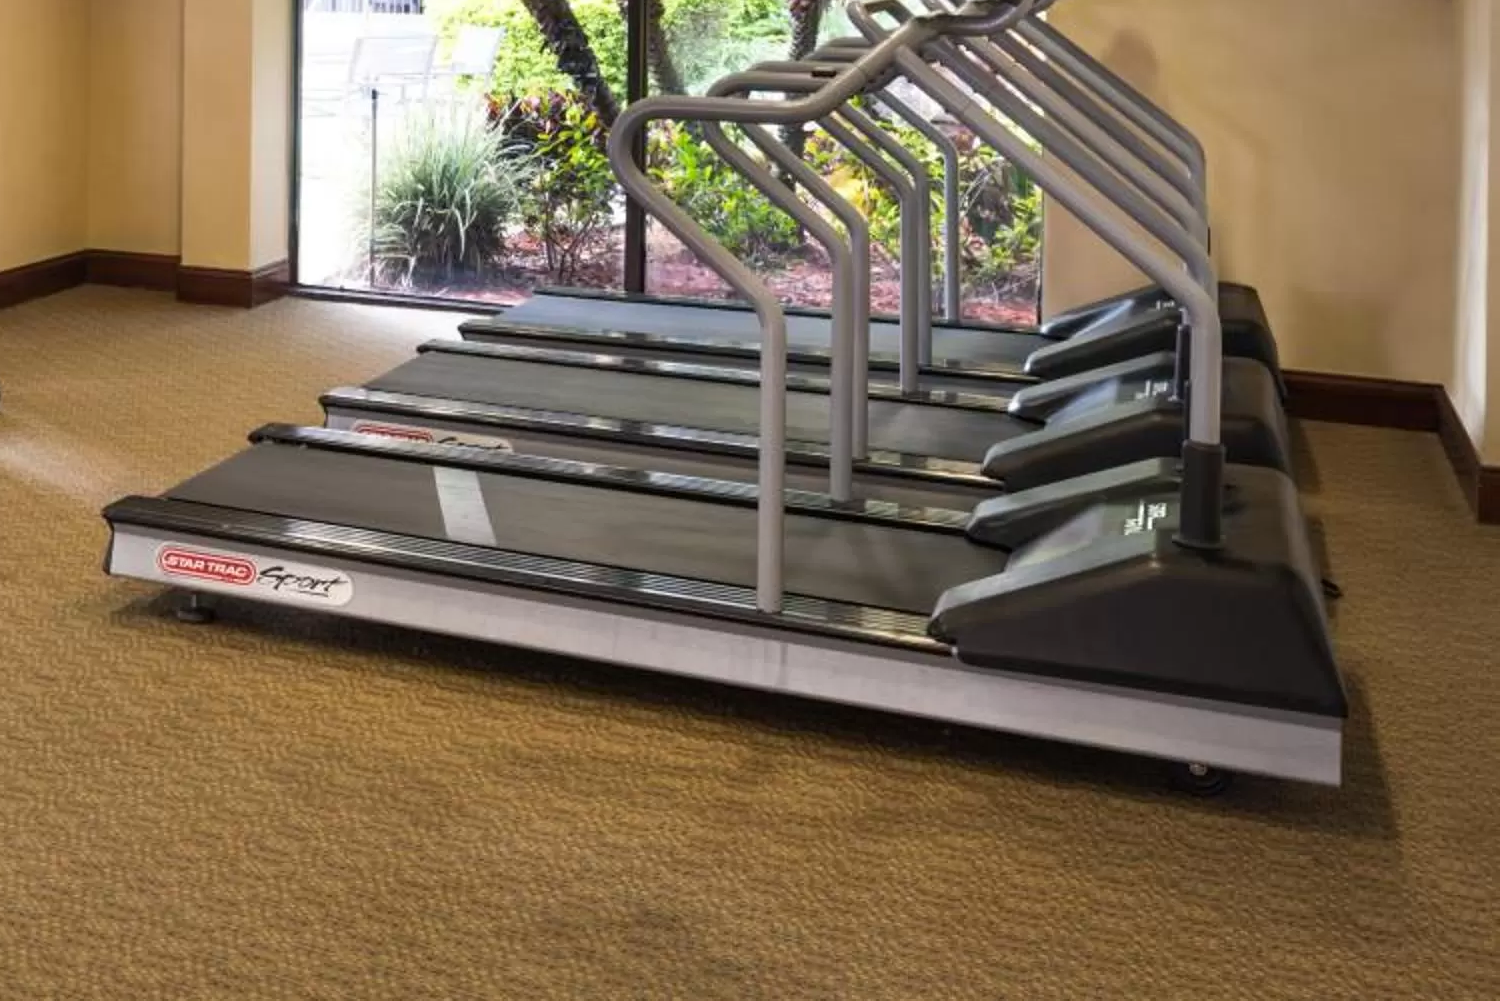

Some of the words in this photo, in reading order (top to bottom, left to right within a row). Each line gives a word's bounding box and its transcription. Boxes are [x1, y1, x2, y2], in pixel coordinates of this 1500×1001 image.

[166, 555, 205, 571] STAR
[207, 561, 248, 579] TRAC
[258, 565, 349, 595] Sport
